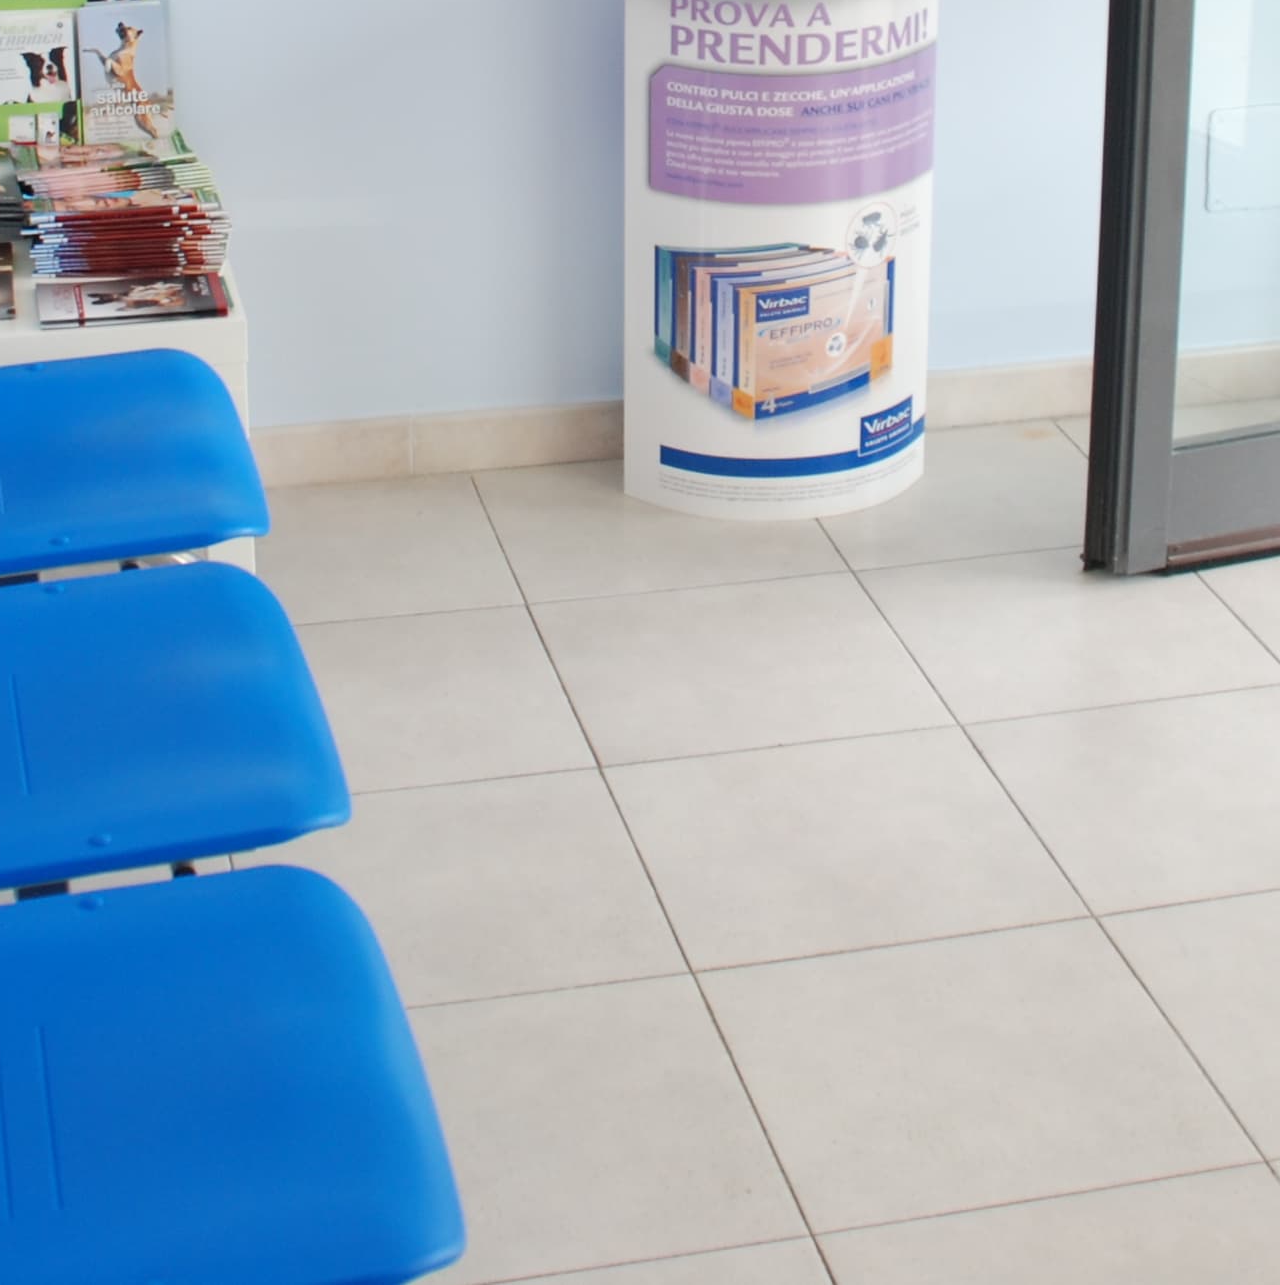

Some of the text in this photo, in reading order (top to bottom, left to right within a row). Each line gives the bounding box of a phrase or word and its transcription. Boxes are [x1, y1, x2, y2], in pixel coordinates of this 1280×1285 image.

[807, 1, 832, 27] A
[670, 7, 929, 66] PRENDERMI!
[96, 87, 149, 105] salute
[666, 81, 719, 99] CONTRO
[721, 85, 760, 102] PULCI
[762, 90, 770, 102] E
[773, 88, 827, 103] ZECCHE,
[90, 104, 161, 117] articolare
[666, 96, 705, 112] DELLA
[706, 100, 754, 117] GIUSTA
[756, 106, 794, 117] DOSE
[757, 295, 808, 311] Virbac
[769, 316, 833, 340] EFFIPRO
[864, 407, 911, 435] Virbac
